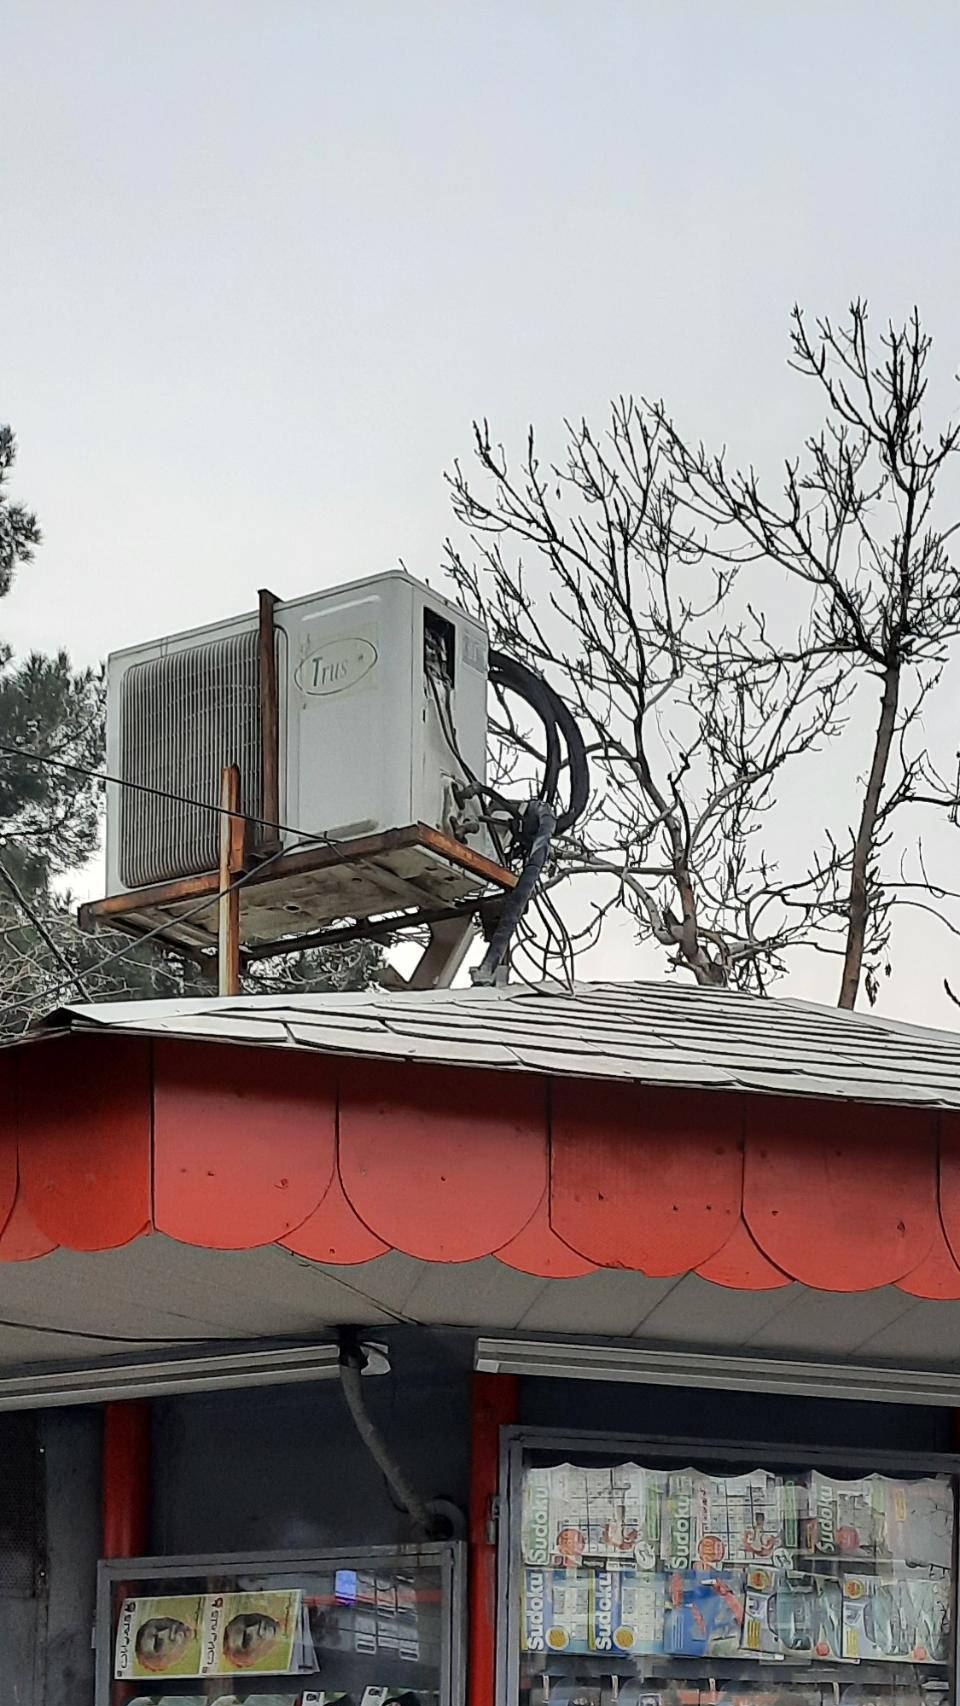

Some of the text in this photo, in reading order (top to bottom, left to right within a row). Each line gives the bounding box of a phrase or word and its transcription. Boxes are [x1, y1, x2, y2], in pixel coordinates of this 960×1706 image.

[528, 1487, 548, 1563] Sudoku
[673, 1496, 688, 1569] Sudoku
[817, 1486, 835, 1552] Sudoku
[527, 1573, 544, 1650] Sudoku
[596, 1572, 612, 1650] Sudoku
